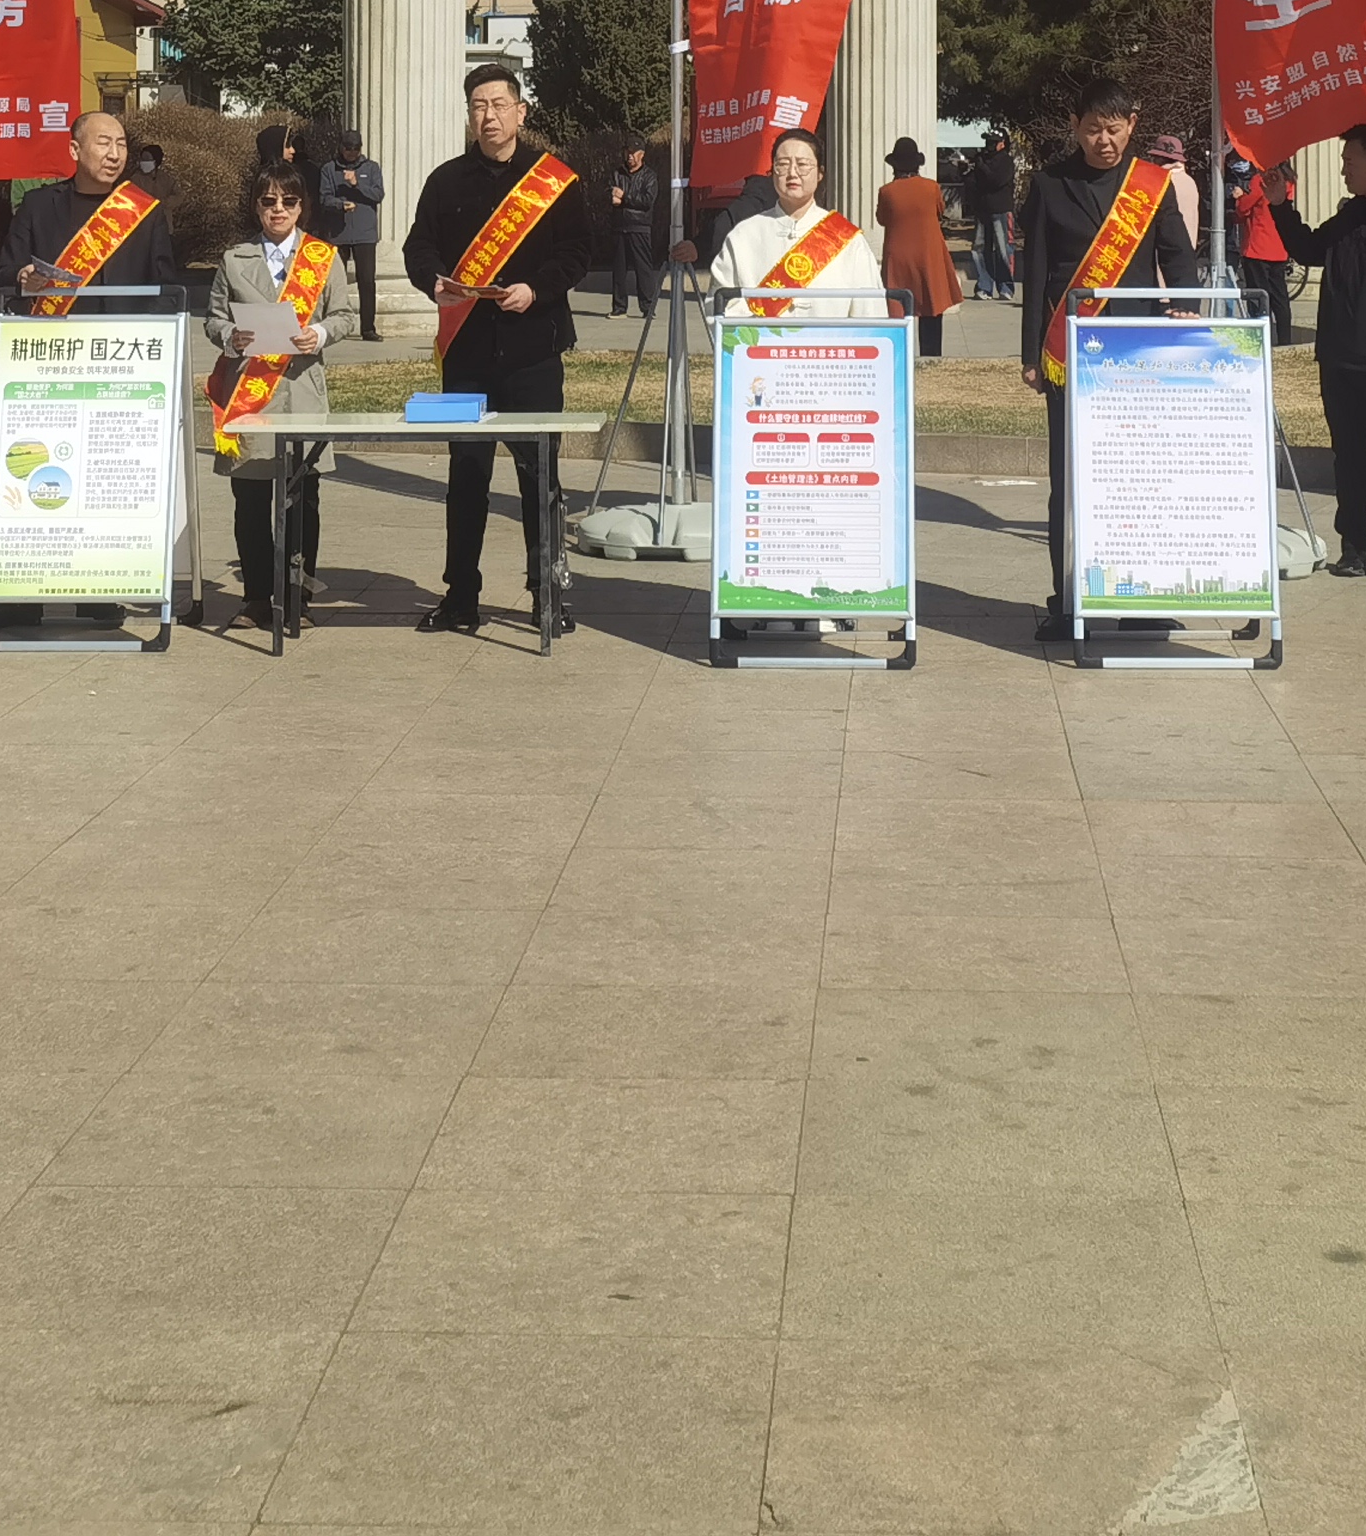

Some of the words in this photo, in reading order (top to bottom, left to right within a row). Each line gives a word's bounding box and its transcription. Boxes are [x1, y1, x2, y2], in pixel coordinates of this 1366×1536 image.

[38, 100, 71, 132] 宣
[768, 95, 809, 130] 宣
[10, 337, 85, 361] 耕地保护
[90, 337, 164, 361] 国之大者
[36, 365, 85, 376] 守护粮食安全
